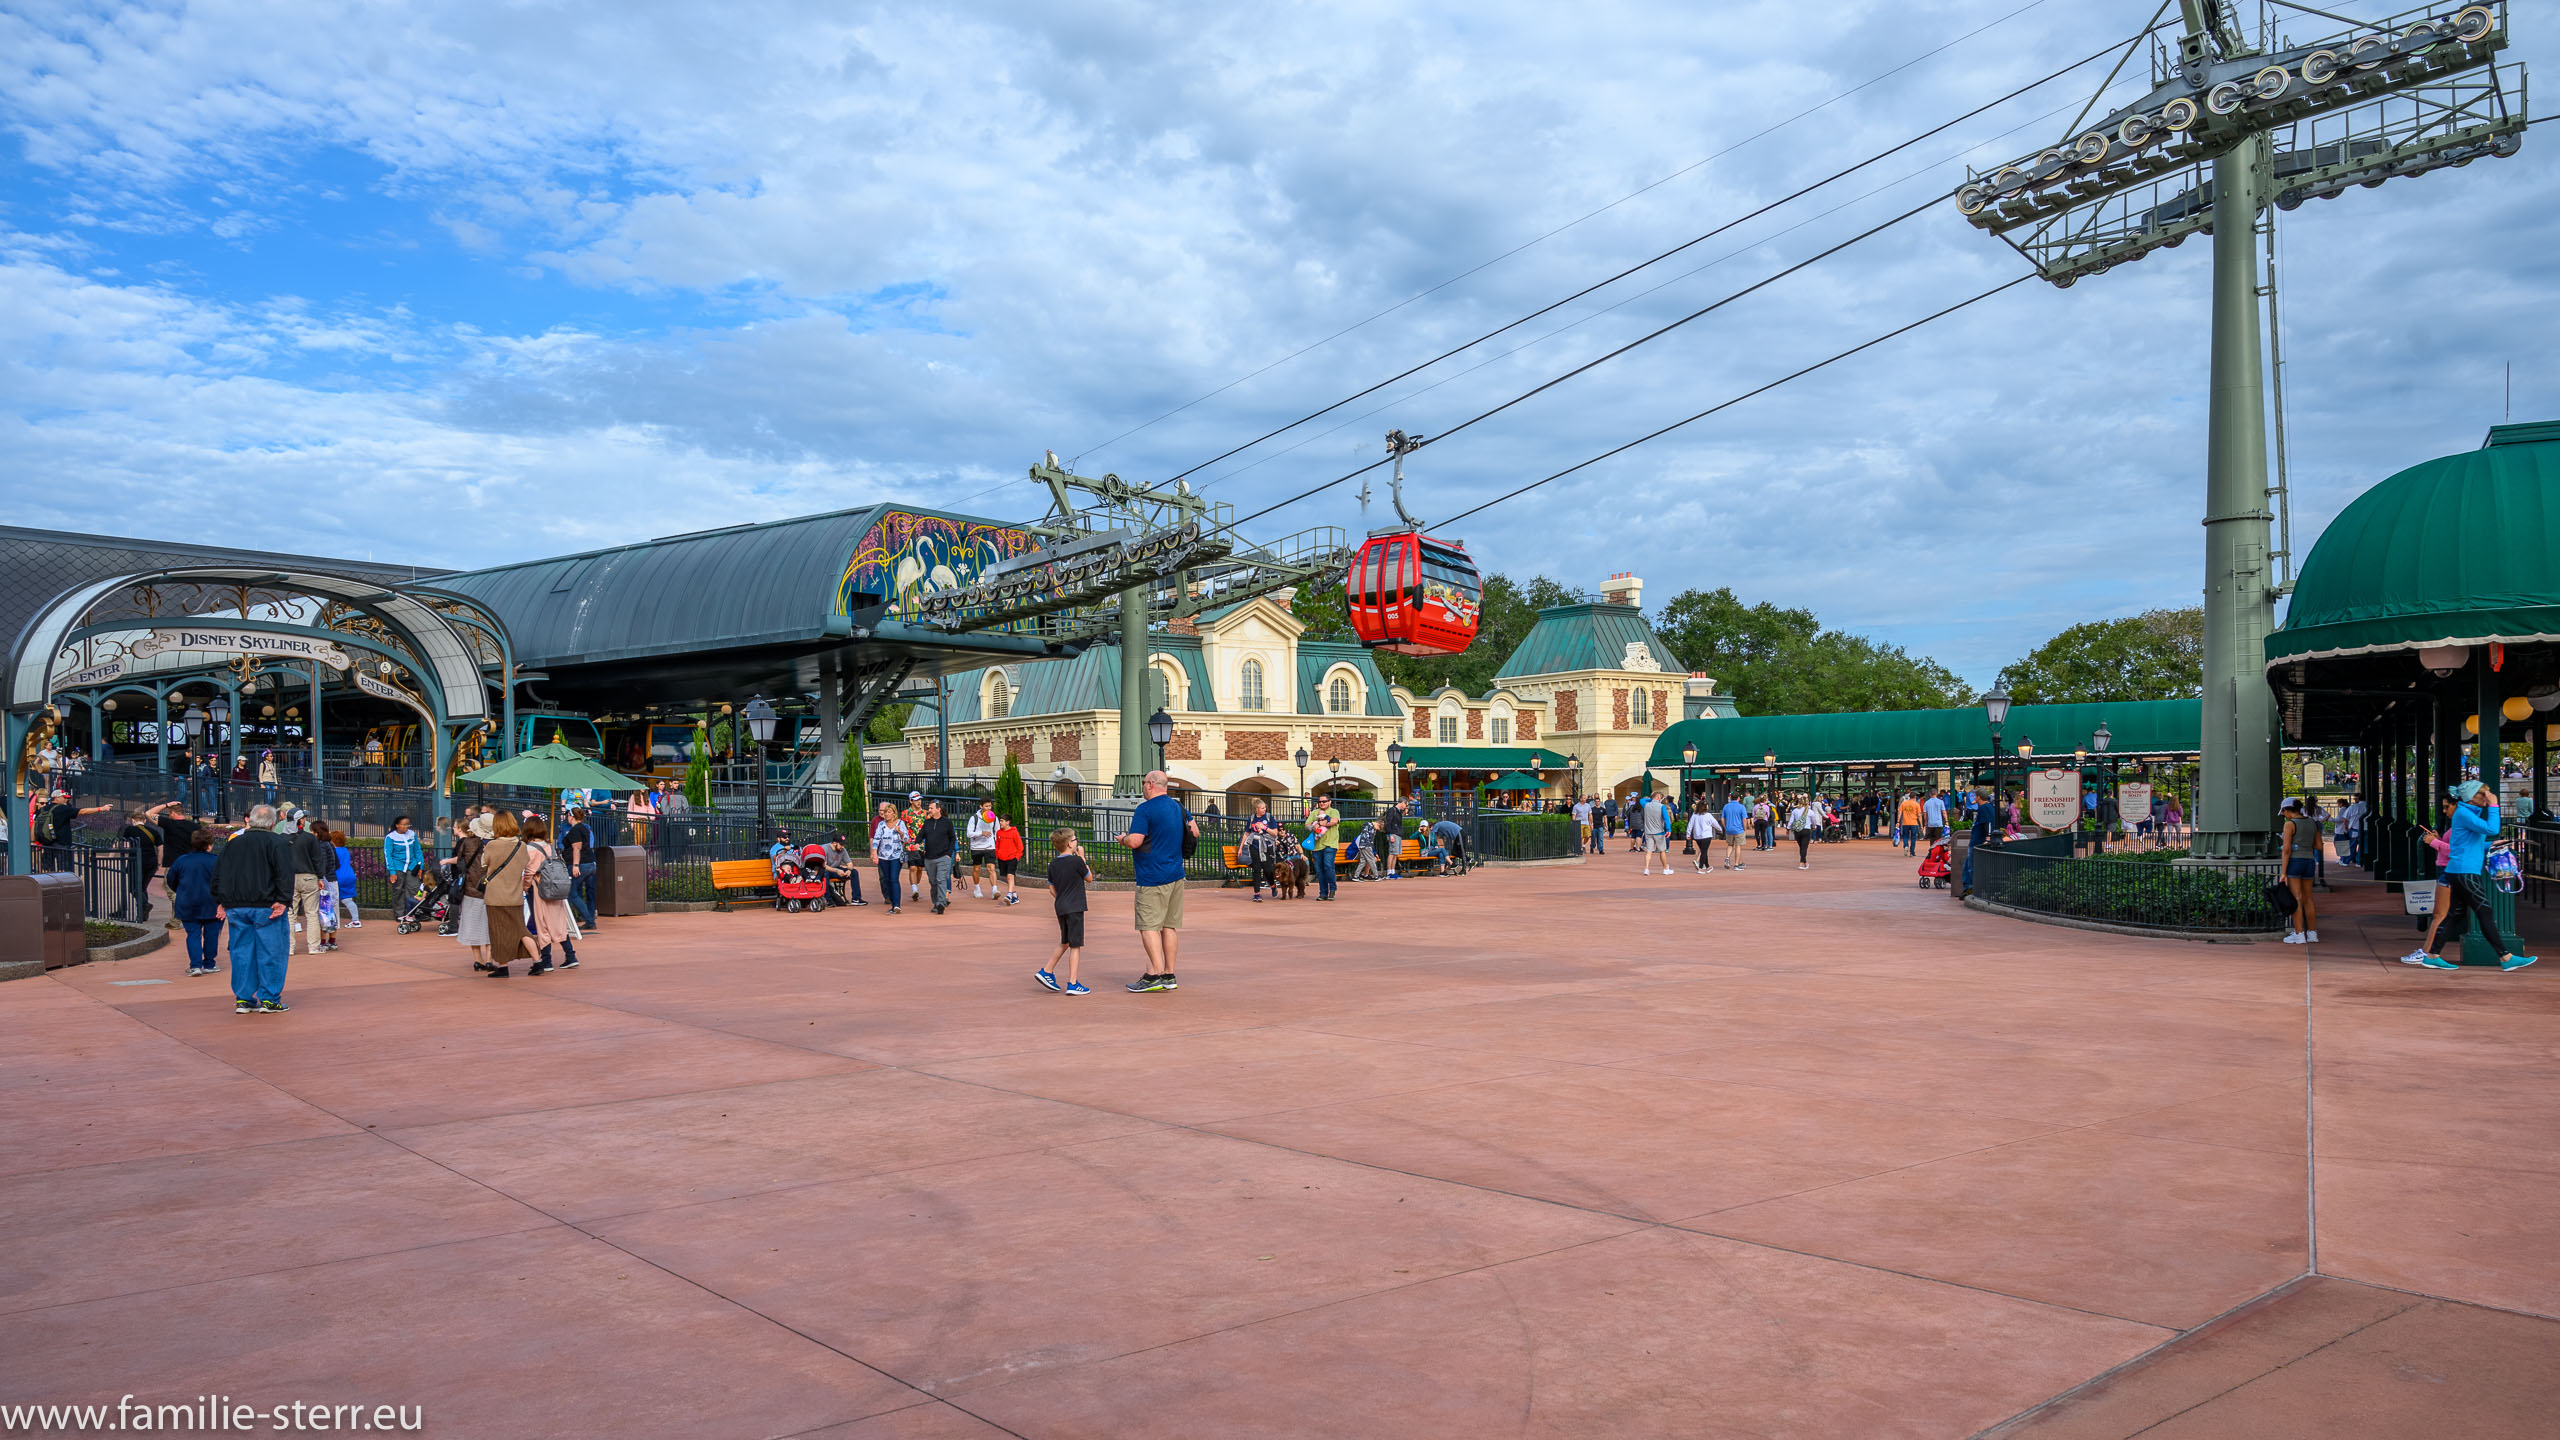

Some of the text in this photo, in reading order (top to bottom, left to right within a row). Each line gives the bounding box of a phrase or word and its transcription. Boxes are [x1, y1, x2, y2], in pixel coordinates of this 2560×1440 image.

[181, 632, 312, 654] DISNEY SKYLINER
[79, 663, 121, 682] ENTER
[361, 677, 394, 697] ENTER
